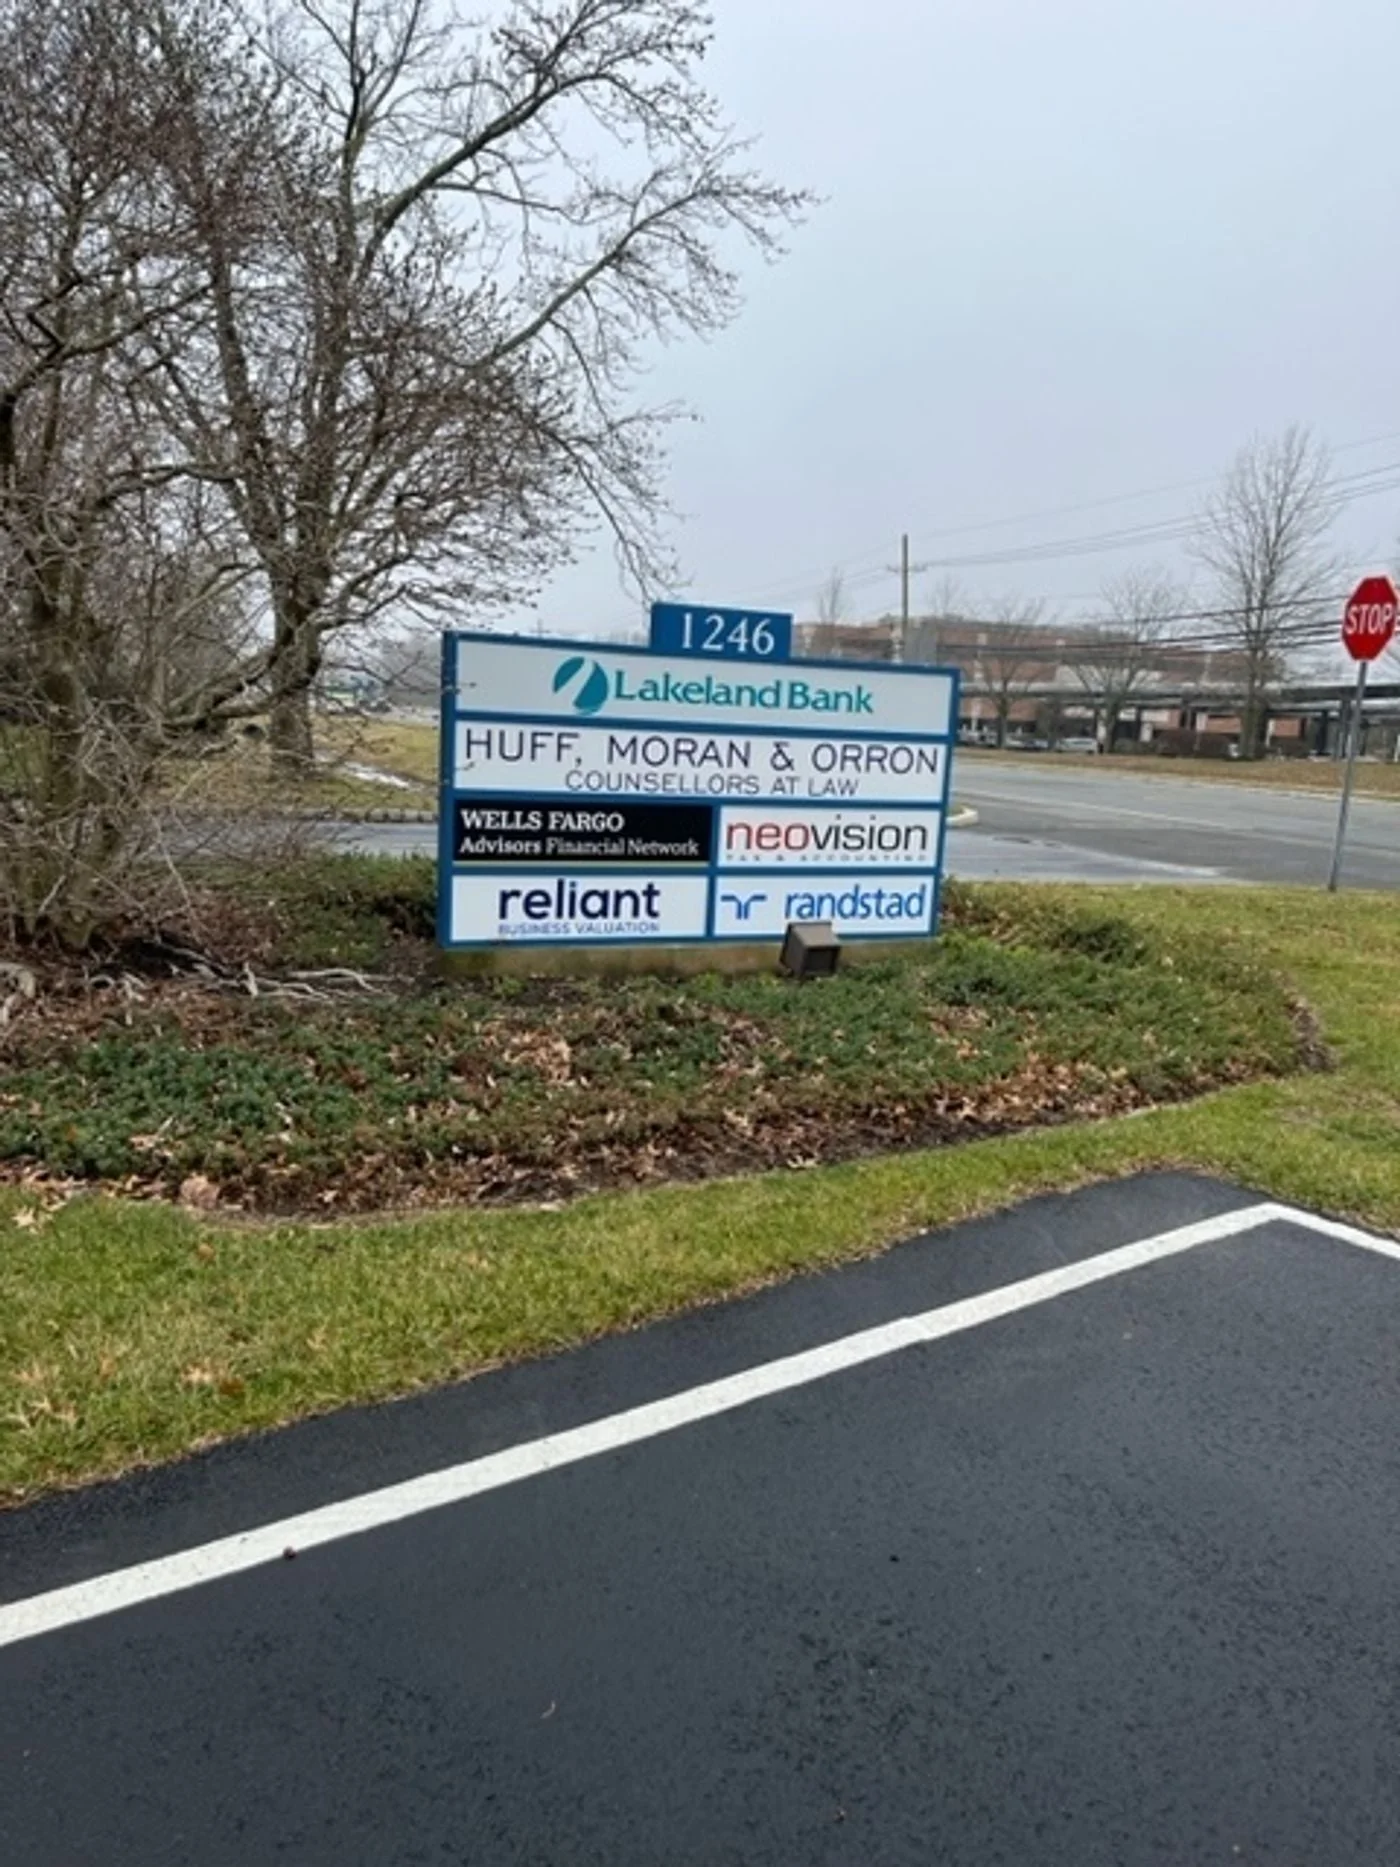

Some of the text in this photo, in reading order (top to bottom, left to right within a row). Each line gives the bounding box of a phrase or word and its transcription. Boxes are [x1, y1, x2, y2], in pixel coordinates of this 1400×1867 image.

[681, 611, 775, 655] 1246
[1345, 603, 1394, 635] STOP
[614, 669, 874, 714] Lakeland Bank
[465, 728, 938, 775] HUFF, MORAN & ORRON
[565, 769, 860, 798] COUNSELLORS AT LAW
[460, 808, 626, 832] WELLS FARGO
[726, 813, 928, 852] neovision
[460, 836, 700, 857] Advisors Financial Network
[498, 878, 661, 920] reliant
[784, 884, 927, 920] randstad
[498, 921, 660, 936] BUSINESS VALUATION
